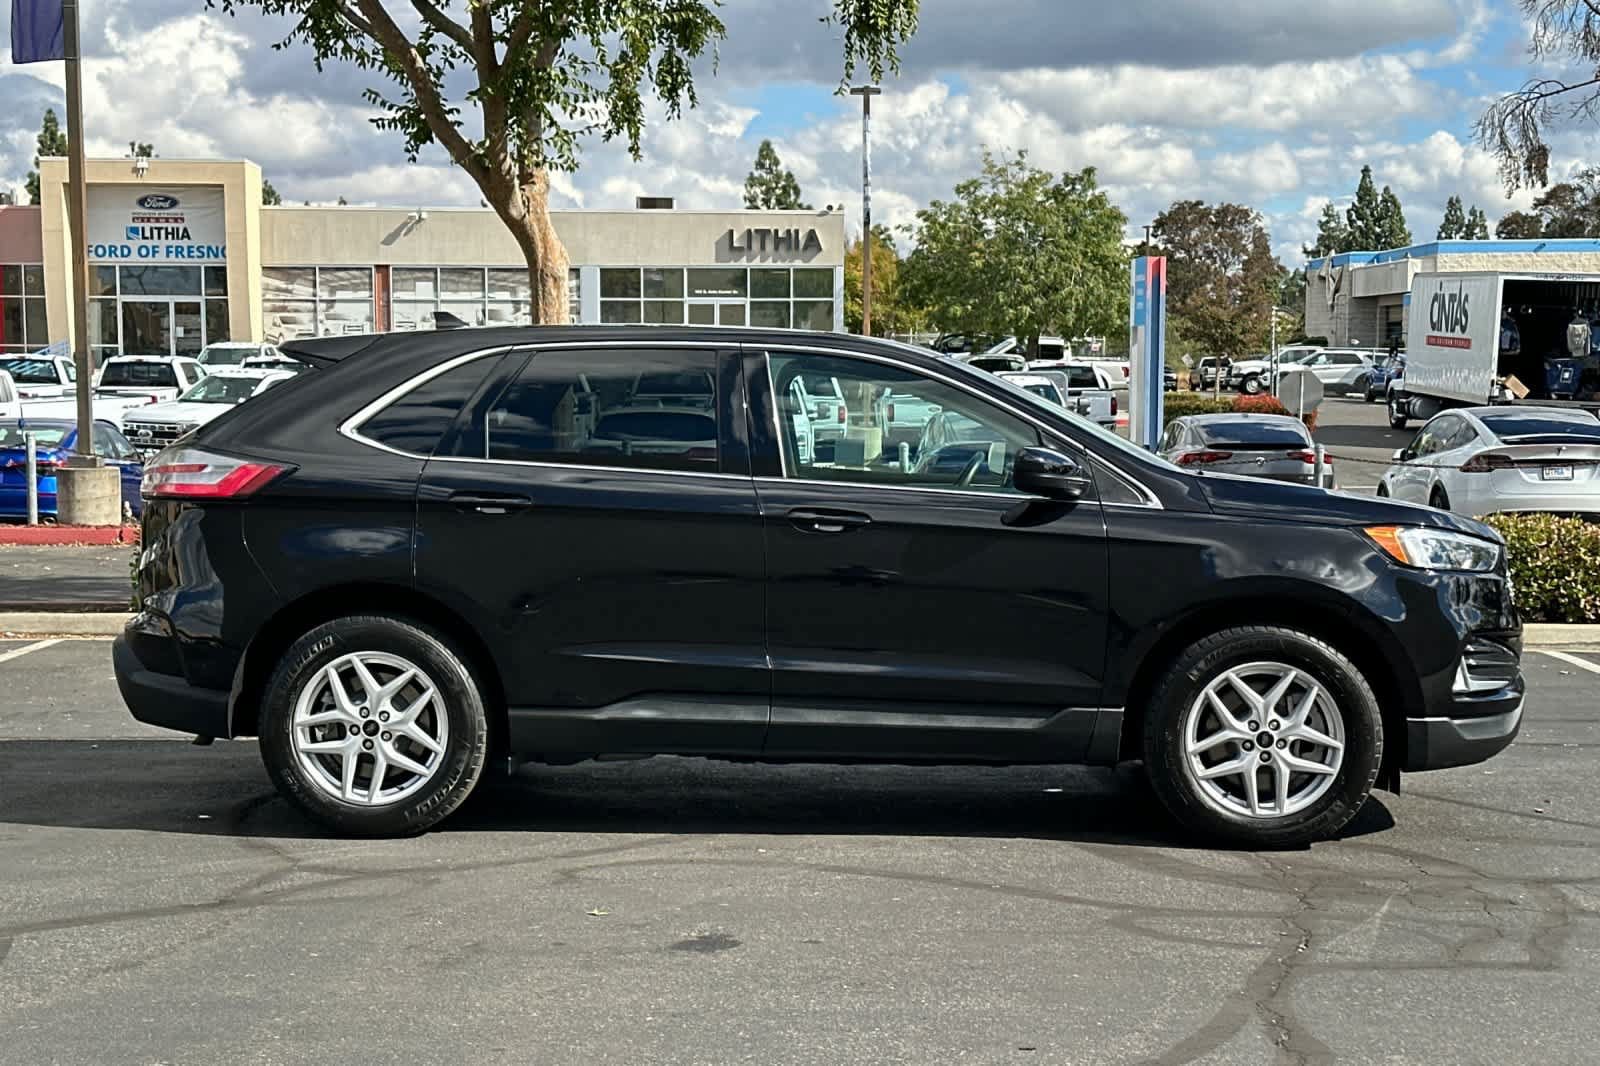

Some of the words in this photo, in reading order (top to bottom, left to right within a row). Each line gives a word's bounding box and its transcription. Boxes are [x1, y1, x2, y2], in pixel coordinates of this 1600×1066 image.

[142, 195, 174, 208] Ford
[141, 226, 192, 241] LITHIA
[727, 228, 822, 251] LITHIA
[87, 244, 132, 259] FORD
[137, 244, 160, 259] OF
[1429, 280, 1469, 334] CINTAS
